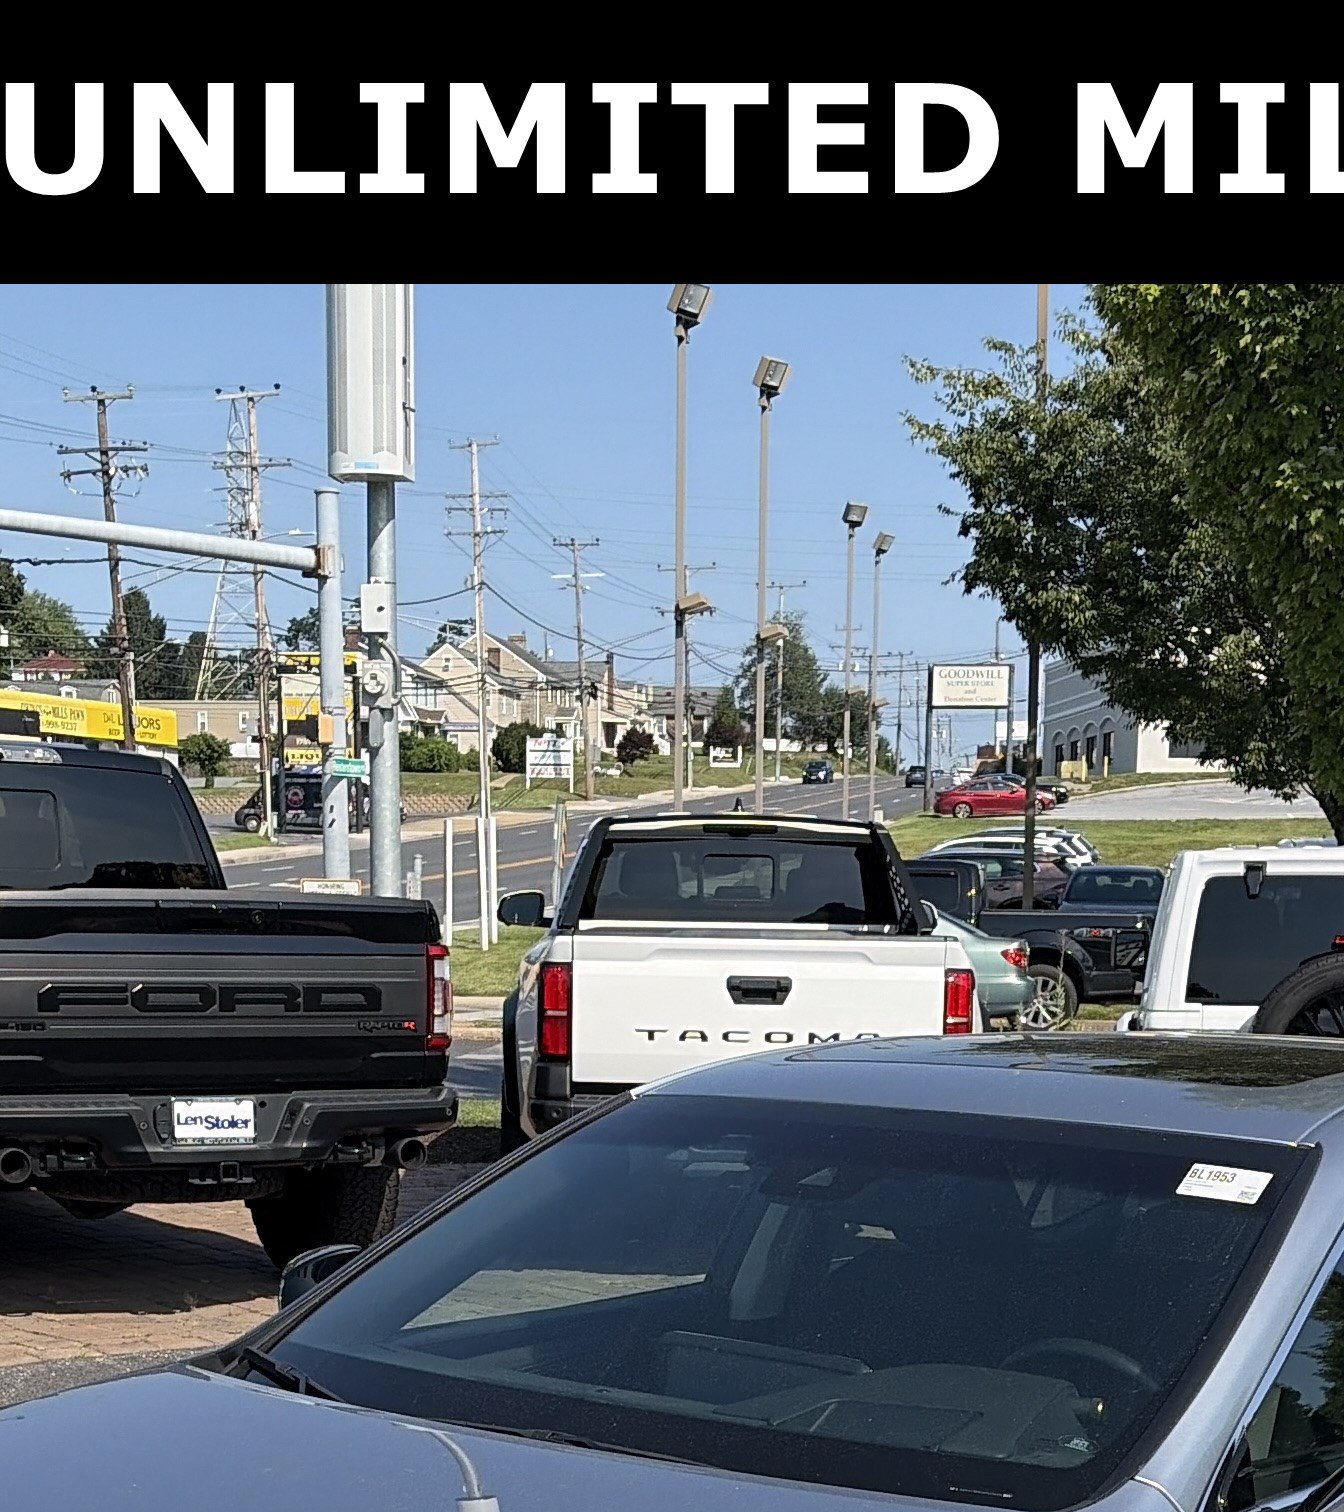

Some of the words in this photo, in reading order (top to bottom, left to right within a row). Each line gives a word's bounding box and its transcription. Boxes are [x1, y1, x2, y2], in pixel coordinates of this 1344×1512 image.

[939, 669, 1003, 679] GOODWILL
[37, 983, 382, 1012] FORD
[358, 1020, 417, 1032] RAPTOR
[1189, 1168, 1237, 1183] BL1953
